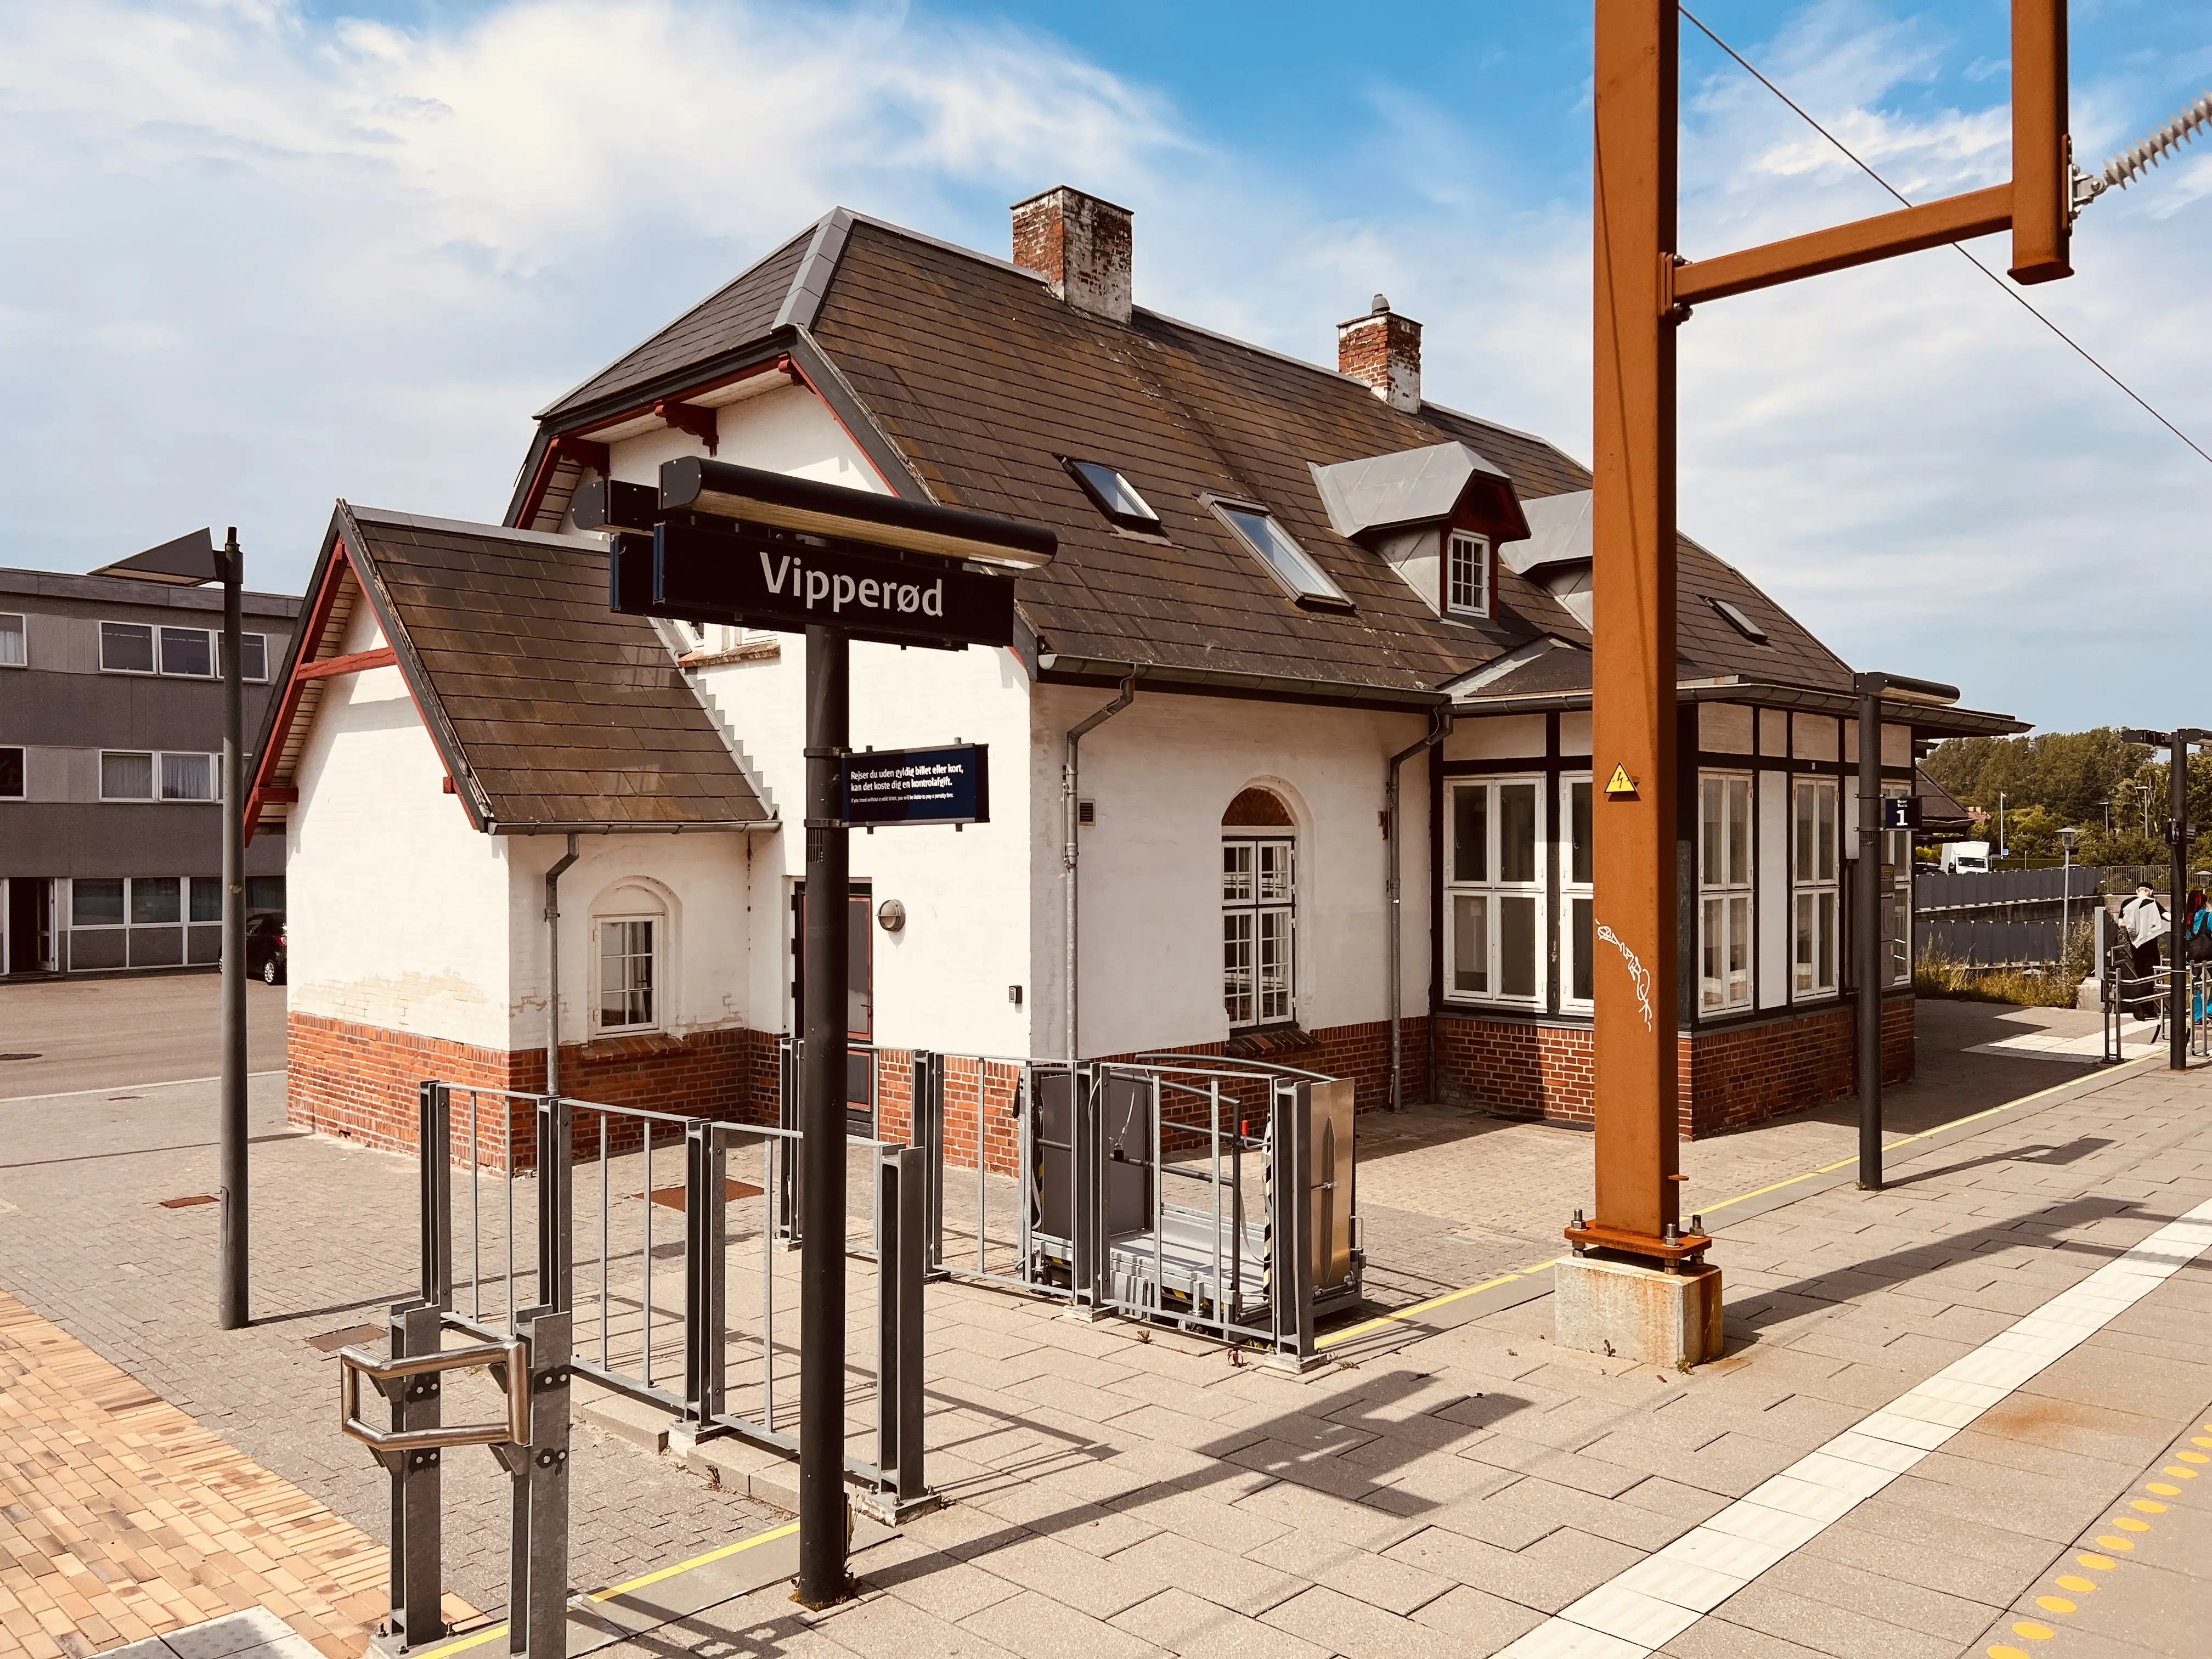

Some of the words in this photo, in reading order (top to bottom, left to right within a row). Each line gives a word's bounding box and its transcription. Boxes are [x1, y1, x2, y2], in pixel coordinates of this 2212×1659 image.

[759, 551, 943, 617] Vipperød
[850, 771, 869, 781] Rejser
[870, 769, 878, 778] du
[879, 769, 894, 778] uden
[895, 766, 915, 778] gyldig
[915, 765, 932, 776] billet
[932, 764, 947, 774] eller
[947, 764, 963, 774] kort,
[851, 783, 862, 792] kan
[863, 782, 873, 791] det
[873, 781, 890, 790] koste
[891, 780, 901, 790] dig
[911, 776, 952, 788] kontrolafgift.
[1896, 809, 1908, 826] 1
